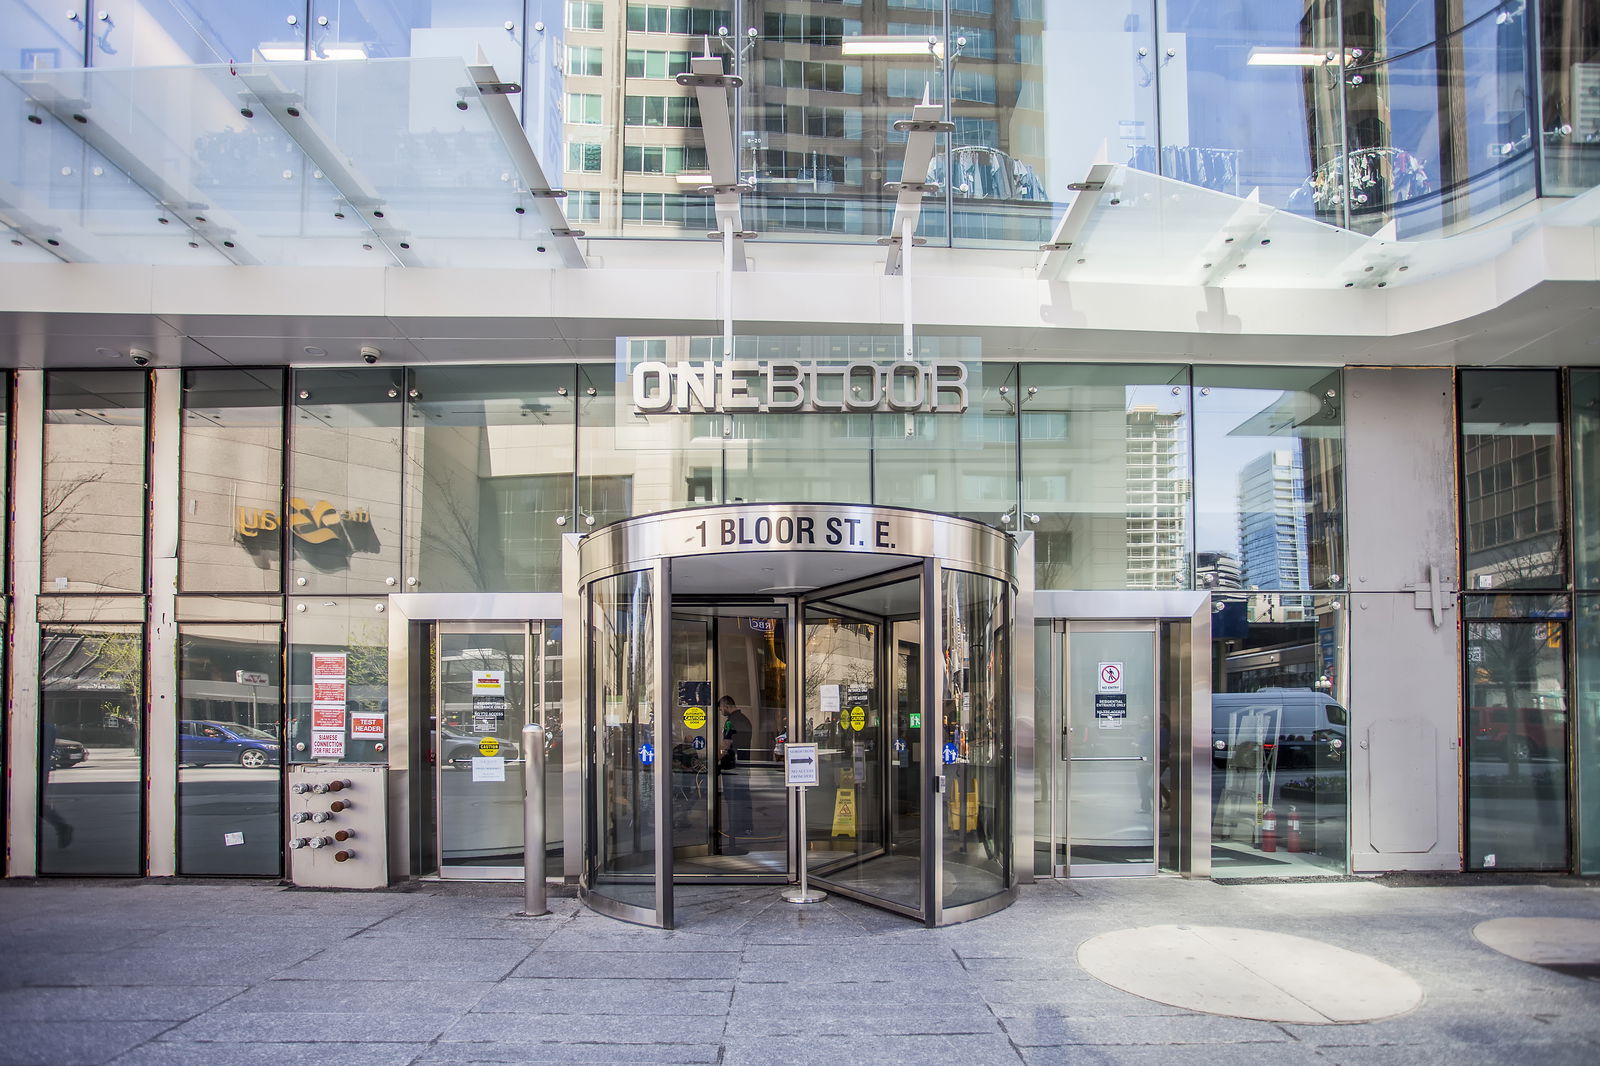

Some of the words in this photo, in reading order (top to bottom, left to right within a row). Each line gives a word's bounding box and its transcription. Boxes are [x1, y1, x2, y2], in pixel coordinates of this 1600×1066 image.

[696, 520, 707, 548] 1
[720, 516, 816, 546] BLOOR
[825, 517, 865, 546] ST.
[875, 520, 896, 549] E.
